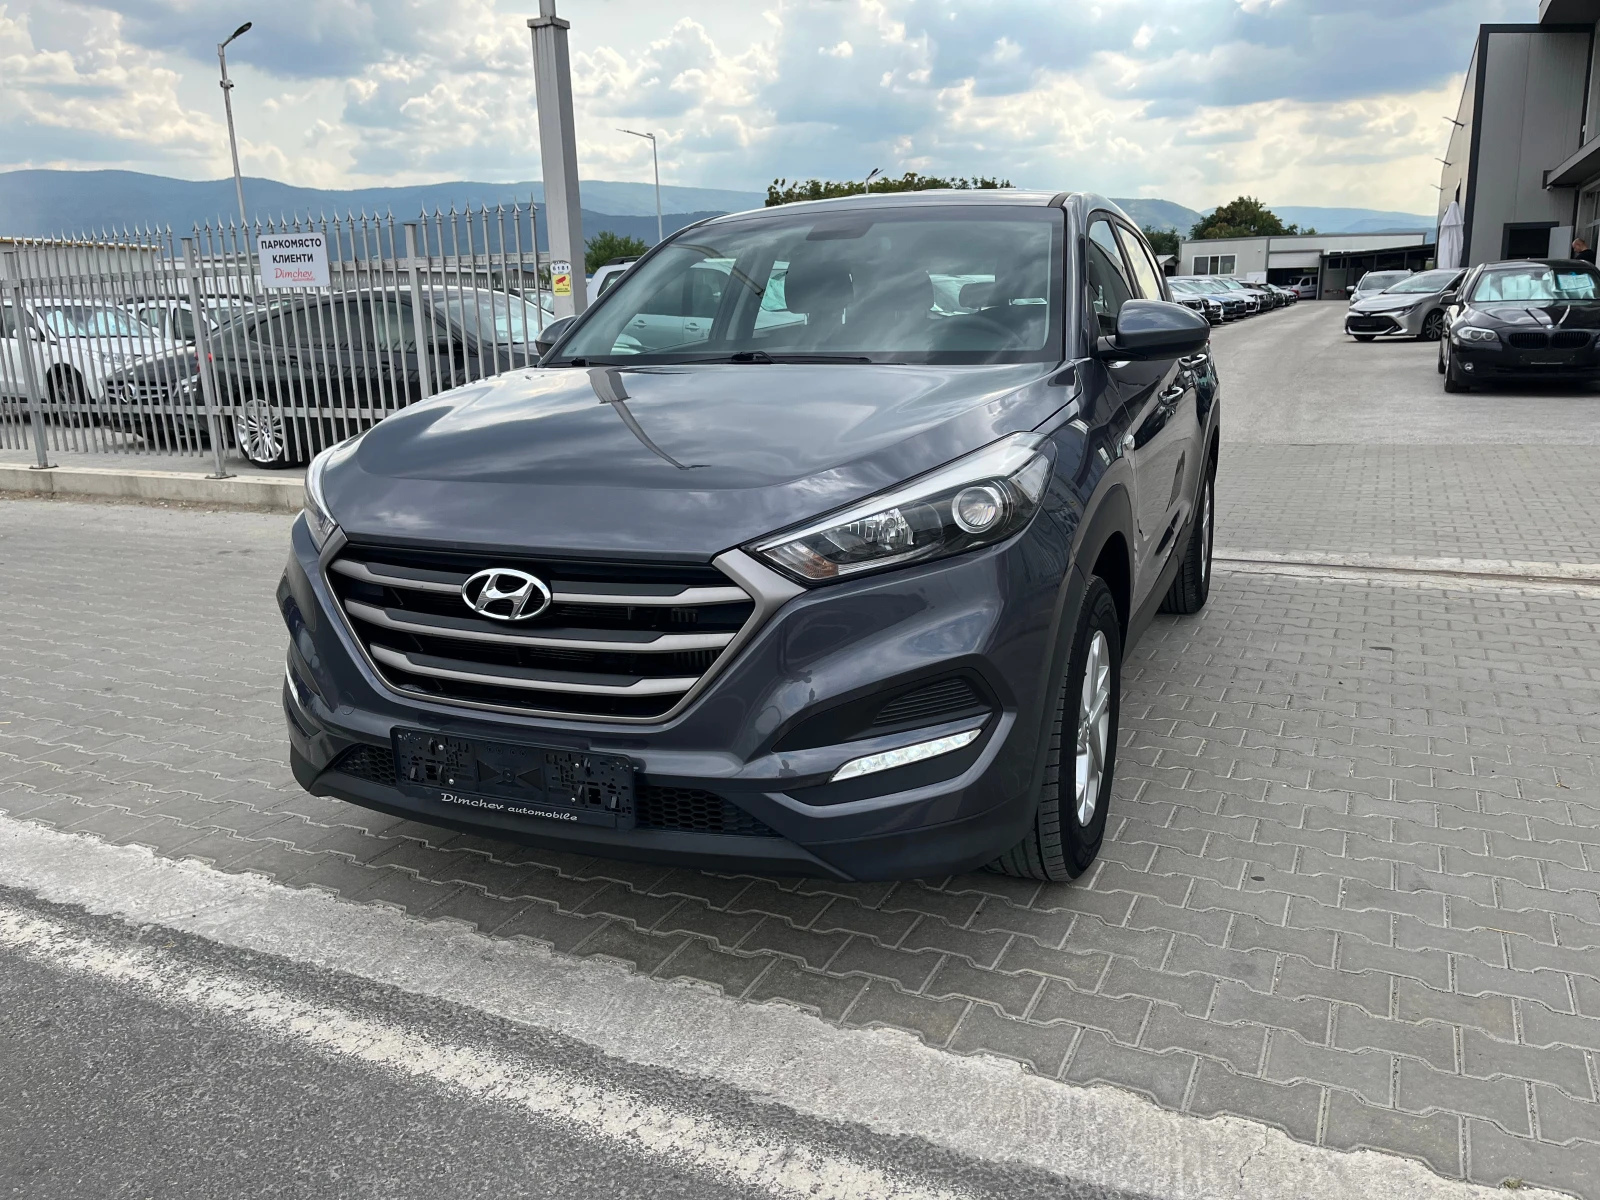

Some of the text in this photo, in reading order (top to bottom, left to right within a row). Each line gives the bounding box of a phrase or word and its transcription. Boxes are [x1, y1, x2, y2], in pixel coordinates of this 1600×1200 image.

[261, 238, 322, 249] ПАРКОМЯСТО
[272, 253, 314, 263] КЛИЕНТИ
[274, 267, 313, 279] Dimchev
[440, 793, 578, 821] Dimchev automobile
